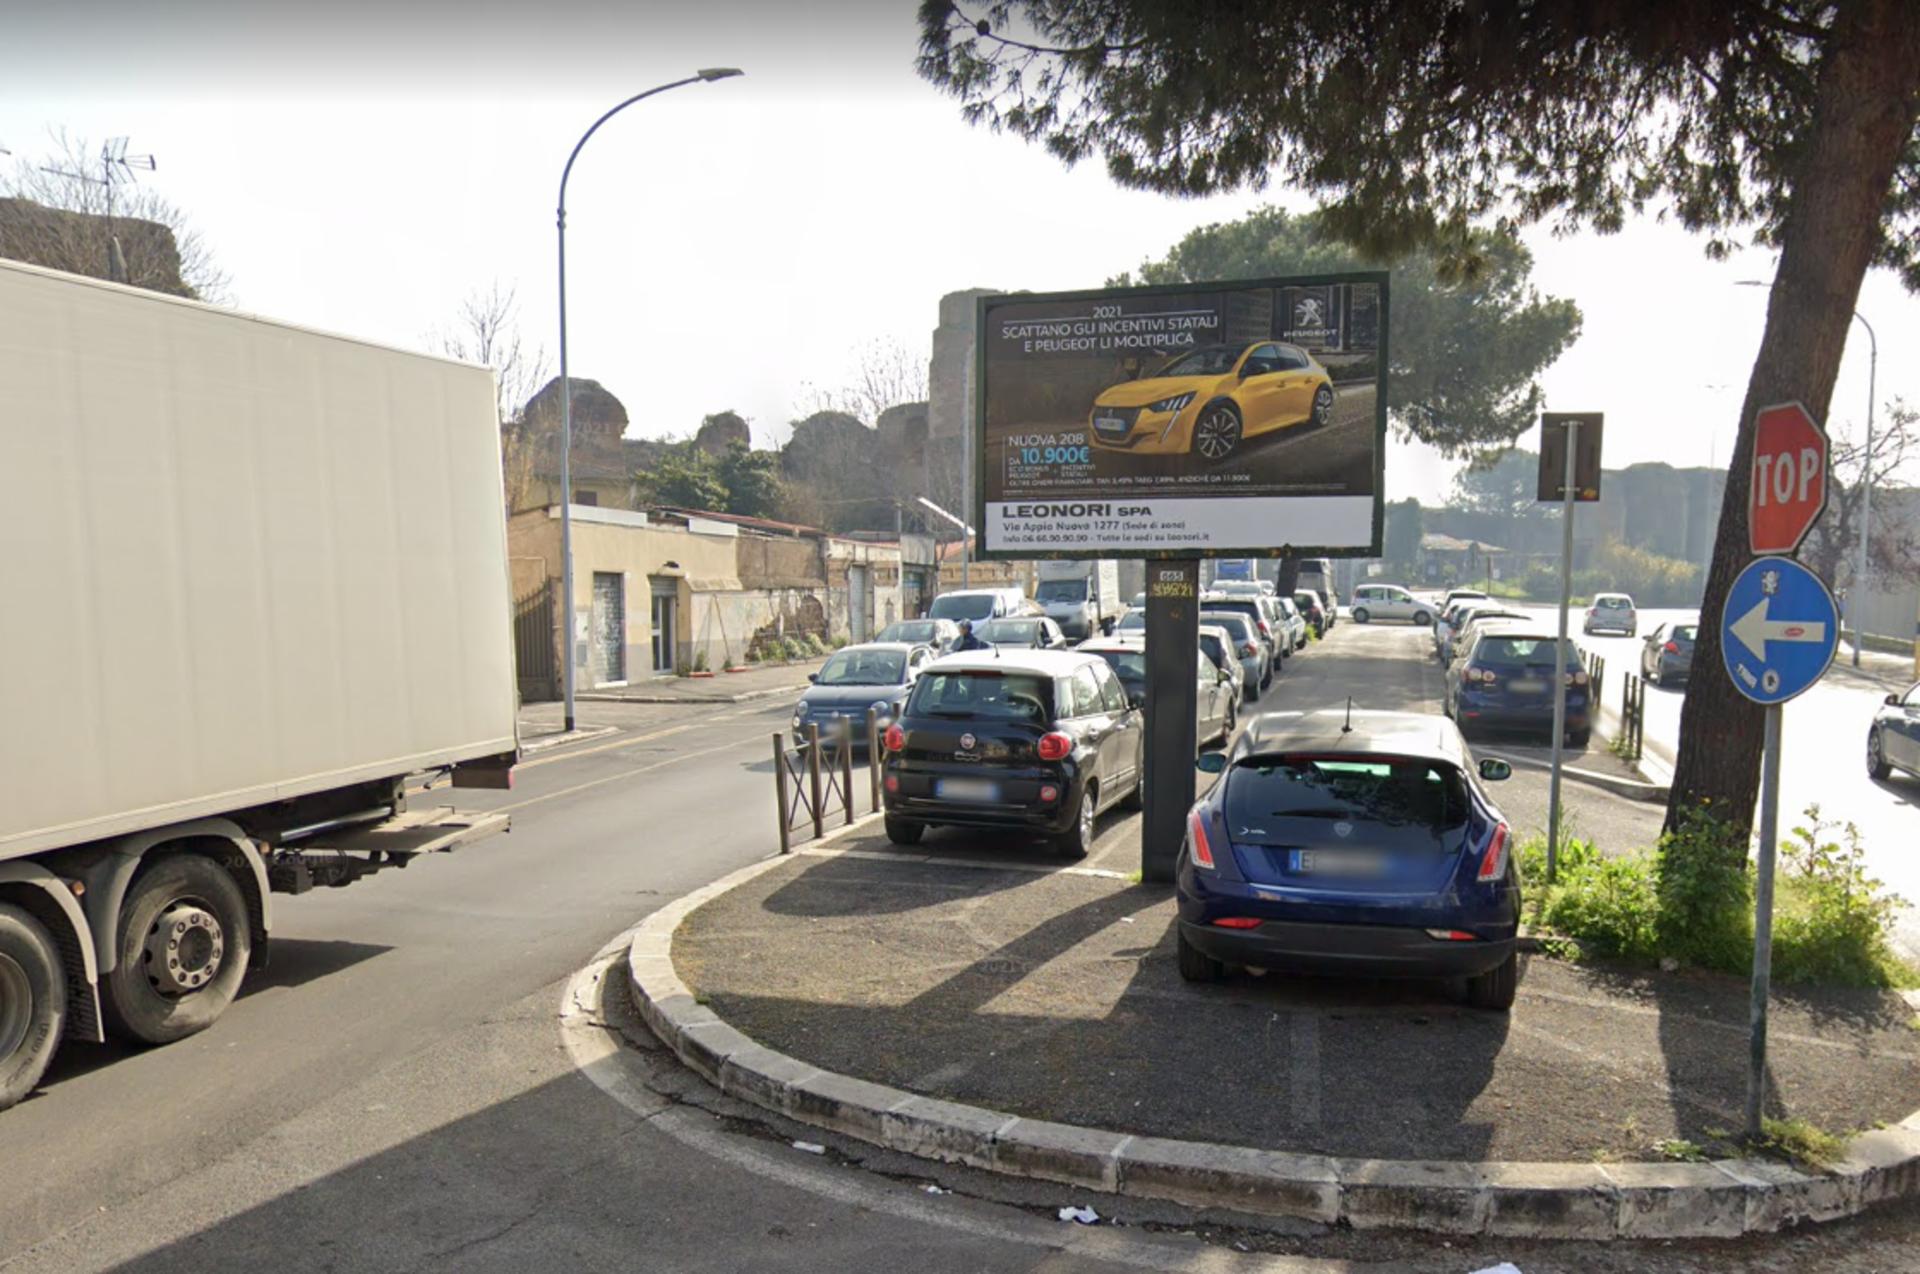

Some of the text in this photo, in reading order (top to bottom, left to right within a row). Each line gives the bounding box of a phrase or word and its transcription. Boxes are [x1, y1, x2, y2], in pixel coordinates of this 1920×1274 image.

[1093, 306, 1122, 319] 2021
[1002, 316, 1219, 339] SCATTANO GLI INCENTIVI STATALI
[1283, 329, 1338, 338] PEUGEOT
[1024, 340, 1032, 352] E
[1035, 337, 1096, 351] PEUGEOT
[1114, 332, 1195, 348] MOLTIPLICA
[1008, 433, 1084, 446] NUOVA 208
[1009, 446, 1089, 465] DA 10.900€
[1002, 503, 1153, 518] LEONORI SPA
[1002, 522, 1020, 532] Via
[1056, 521, 1090, 531] Nuova
[1094, 520, 1120, 530] 1277
